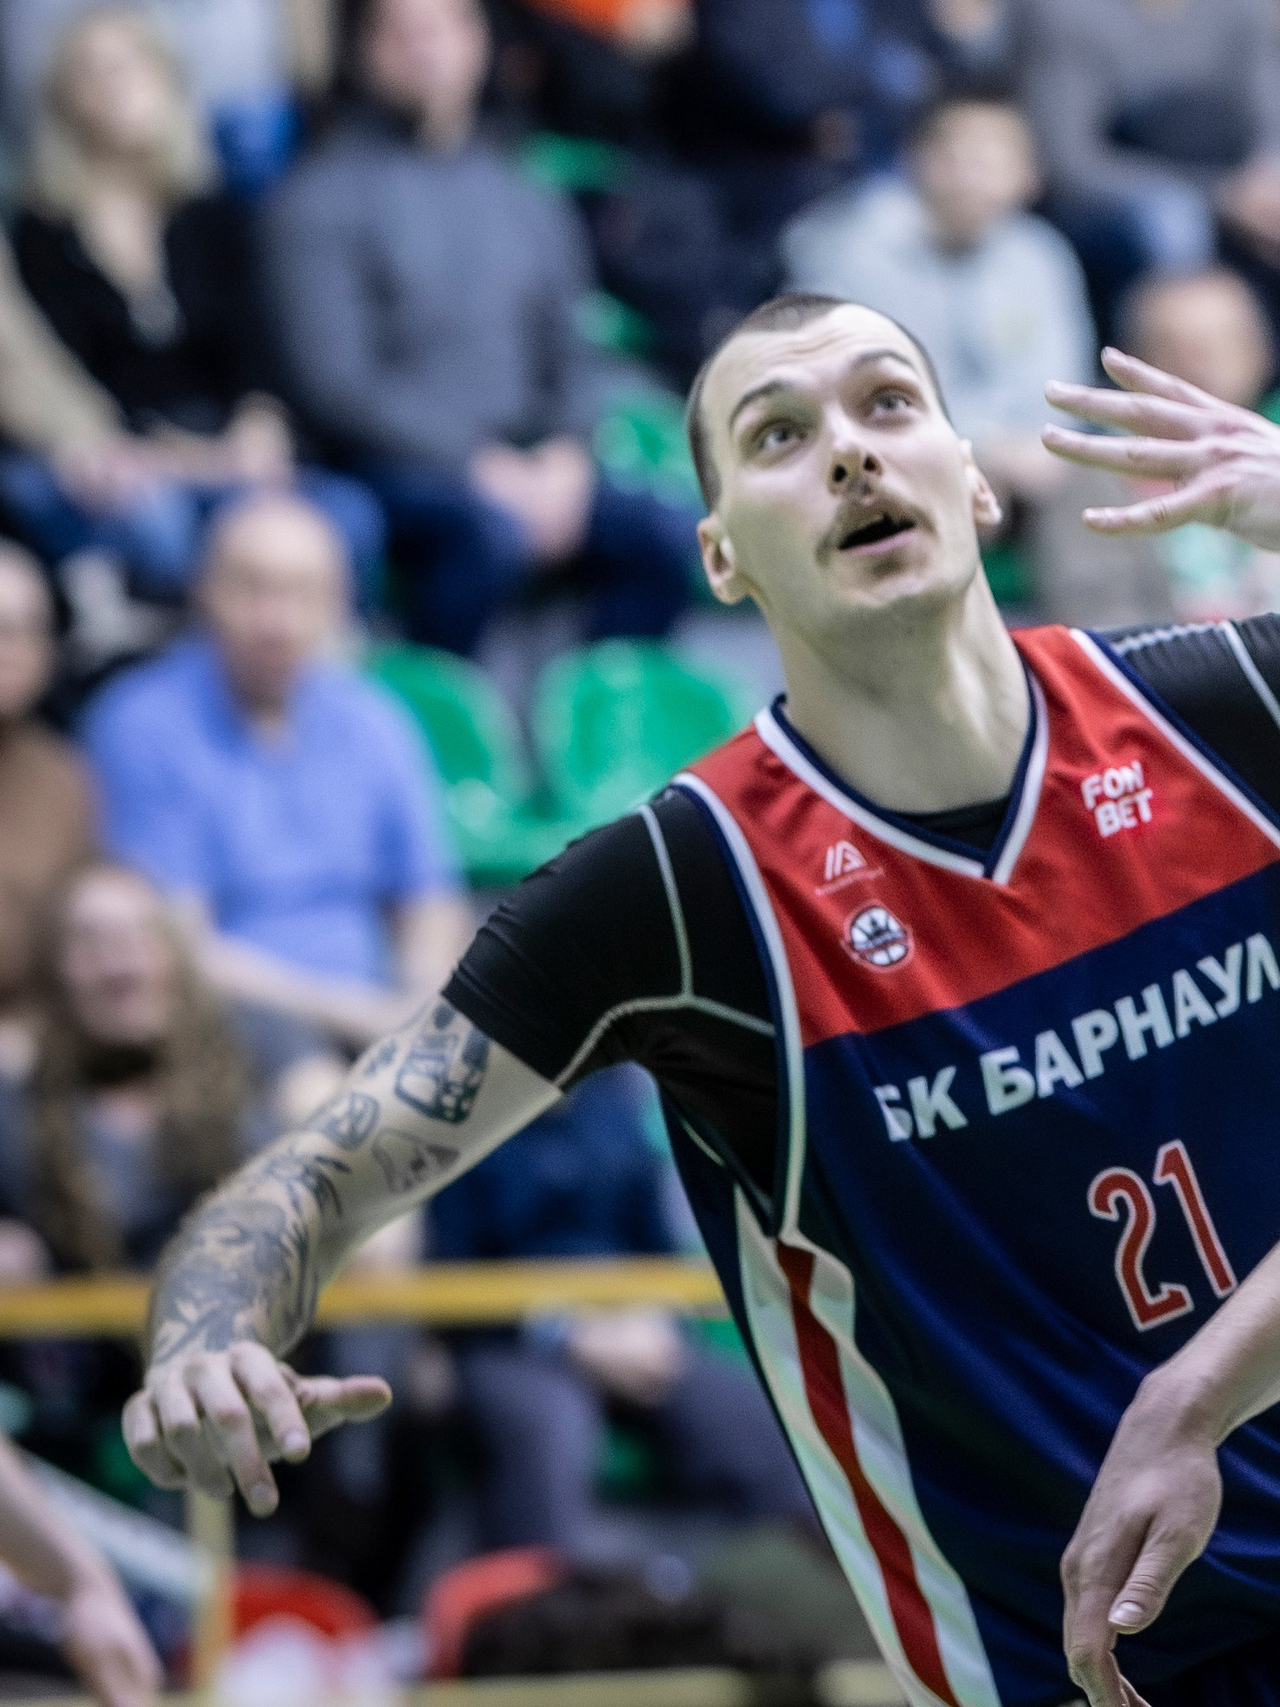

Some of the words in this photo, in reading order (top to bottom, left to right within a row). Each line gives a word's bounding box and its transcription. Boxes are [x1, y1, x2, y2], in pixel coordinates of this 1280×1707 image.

[1081, 760, 1144, 810] FON
[1094, 788, 1153, 838] BET
[874, 1065, 969, 1143] БК
[1087, 1138, 1238, 1334] 21
